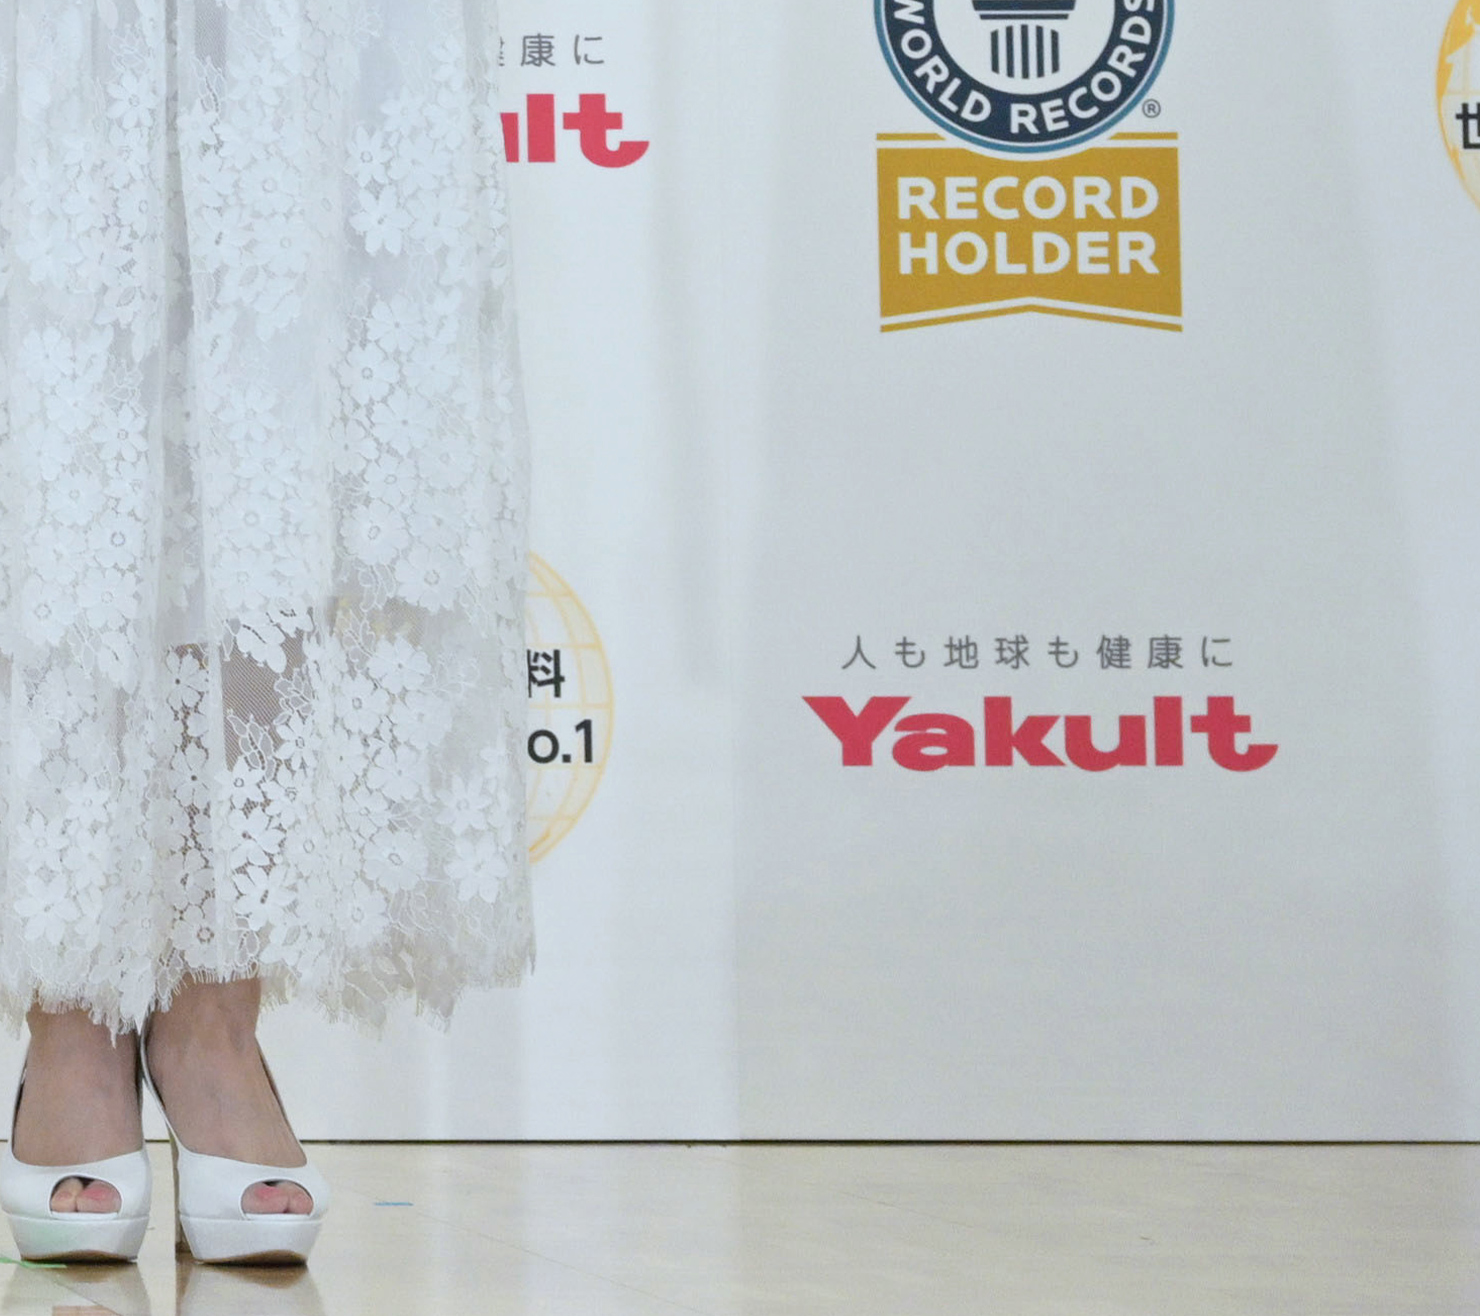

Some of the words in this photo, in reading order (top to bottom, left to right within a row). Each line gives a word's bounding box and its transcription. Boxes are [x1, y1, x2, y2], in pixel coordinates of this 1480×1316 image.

[897, 175, 1160, 221] RECORD
[898, 231, 1160, 277] HOLDER
[841, 633, 1235, 671] 人も地球も健康に
[803, 695, 1279, 773] Yakult
